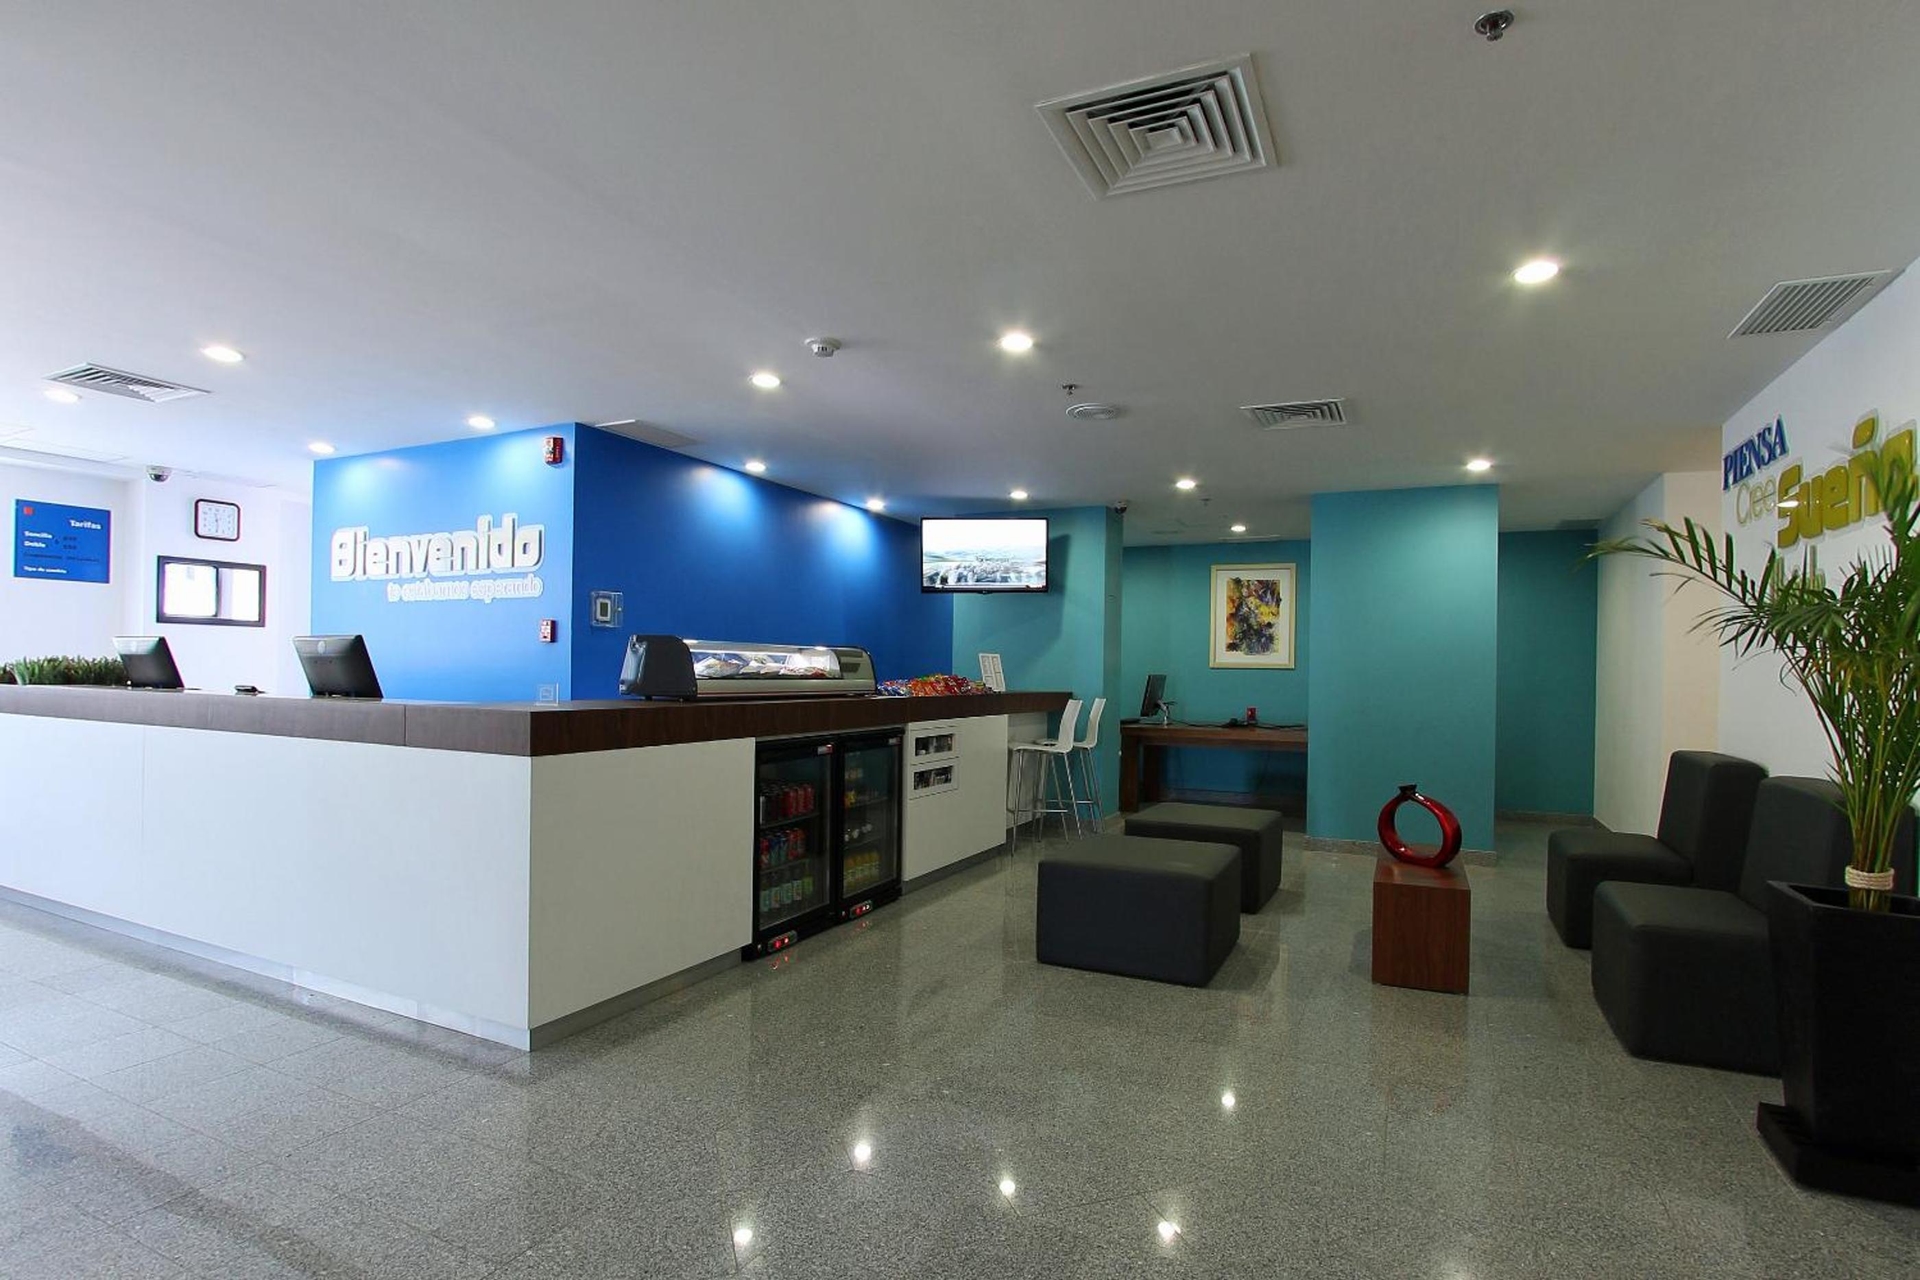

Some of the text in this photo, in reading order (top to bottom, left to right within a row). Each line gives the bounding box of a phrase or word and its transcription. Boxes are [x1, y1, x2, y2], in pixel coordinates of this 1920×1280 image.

[1722, 415, 1788, 491] PIENSA
[69, 519, 102, 530] Tarifas
[331, 512, 544, 580] Bienvenido
[470, 573, 543, 603] esperando
